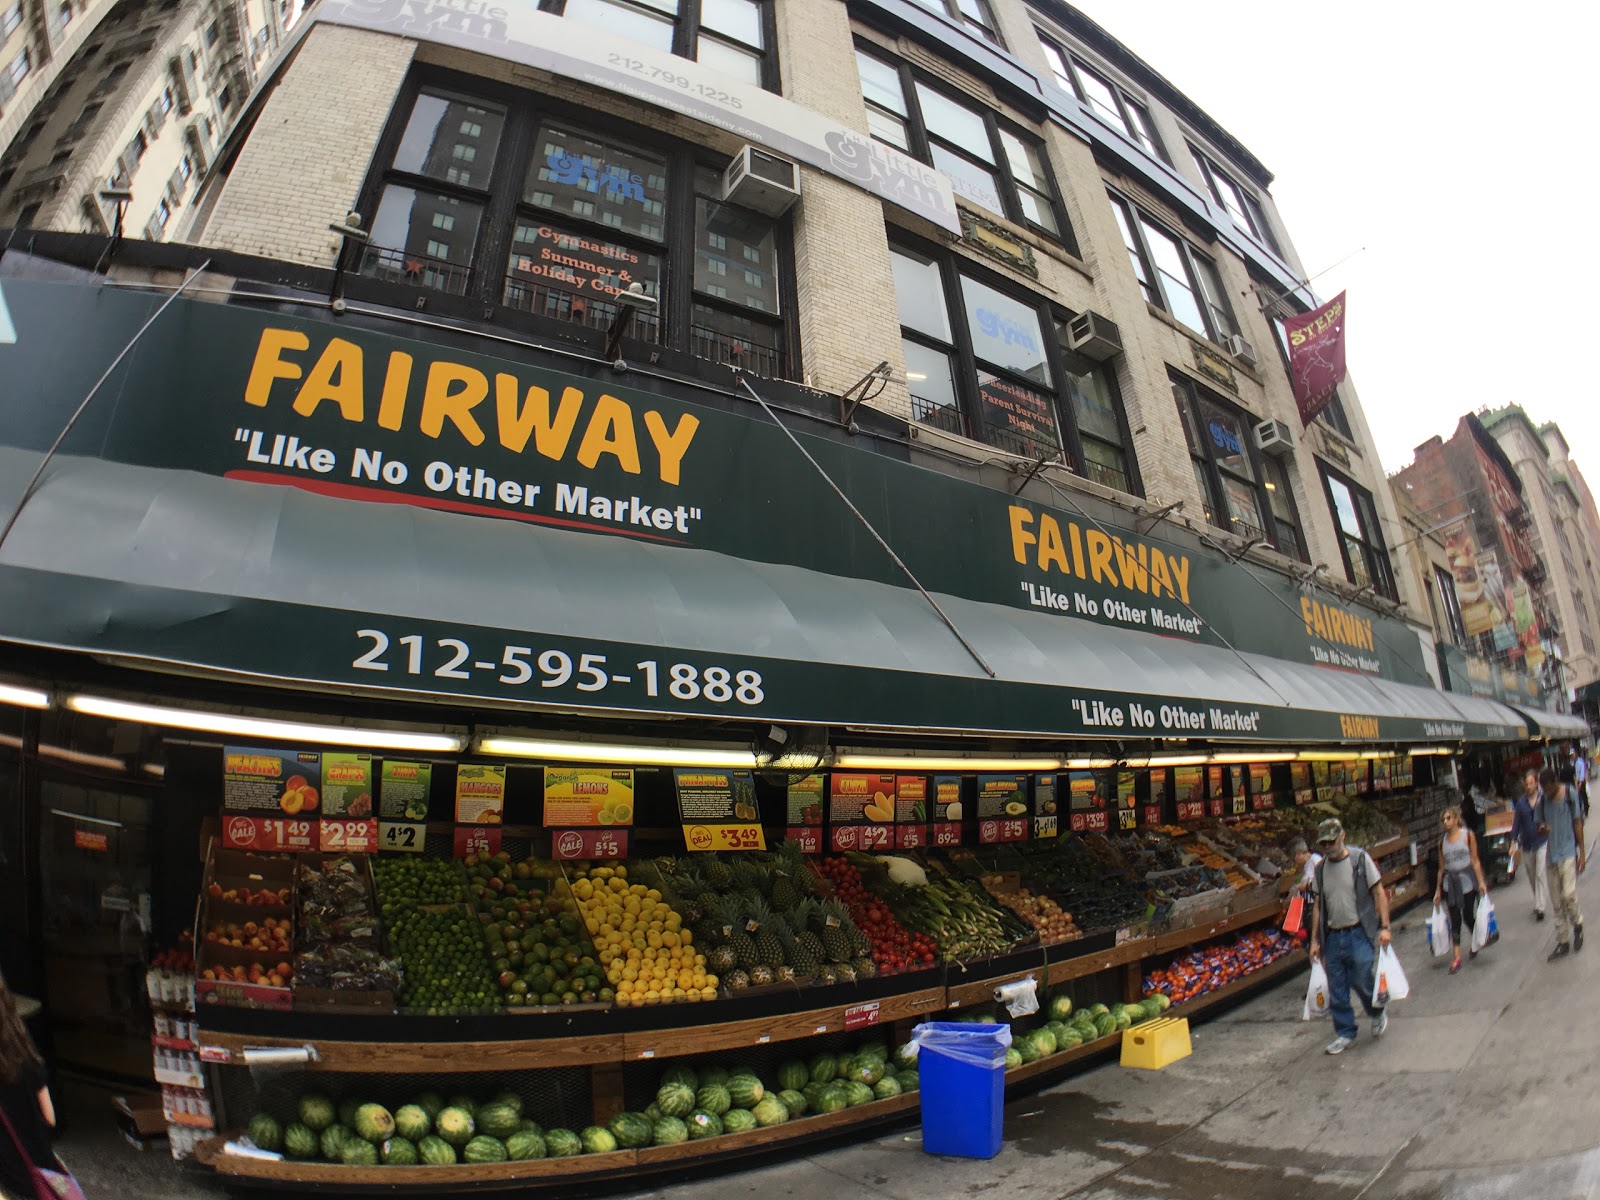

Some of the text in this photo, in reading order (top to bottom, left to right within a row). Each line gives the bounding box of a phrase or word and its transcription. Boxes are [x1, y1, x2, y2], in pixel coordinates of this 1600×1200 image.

[608, 52, 744, 110] 212.799.1225
[546, 153, 652, 203] gym
[824, 131, 949, 213] gym
[870, 142, 938, 189] Little
[538, 226, 638, 264] Gymnastics
[541, 248, 632, 282] Summer &
[518, 258, 586, 289] Holiday
[1289, 301, 1342, 346] STEPS
[244, 327, 700, 486] FAIRWAY
[981, 389, 1054, 428] Parent Survival
[988, 380, 1047, 411] heerleading
[1008, 413, 1035, 432] Night
[351, 448, 409, 485] No
[424, 461, 541, 507] Other
[555, 482, 702, 534] Market"
[1008, 505, 1190, 605] FAIRWAY
[1021, 581, 1203, 635] "Like No Other Market"
[1300, 596, 1375, 653] FAIRWAY
[352, 628, 765, 705] 212-595-1888
[1071, 698, 1260, 732] "Like No Other Market"
[1340, 714, 1379, 739] FAIRWAY
[225, 754, 282, 777] PEACHES
[573, 782, 608, 794] LEMONS
[692, 834, 712, 845] DEAL
